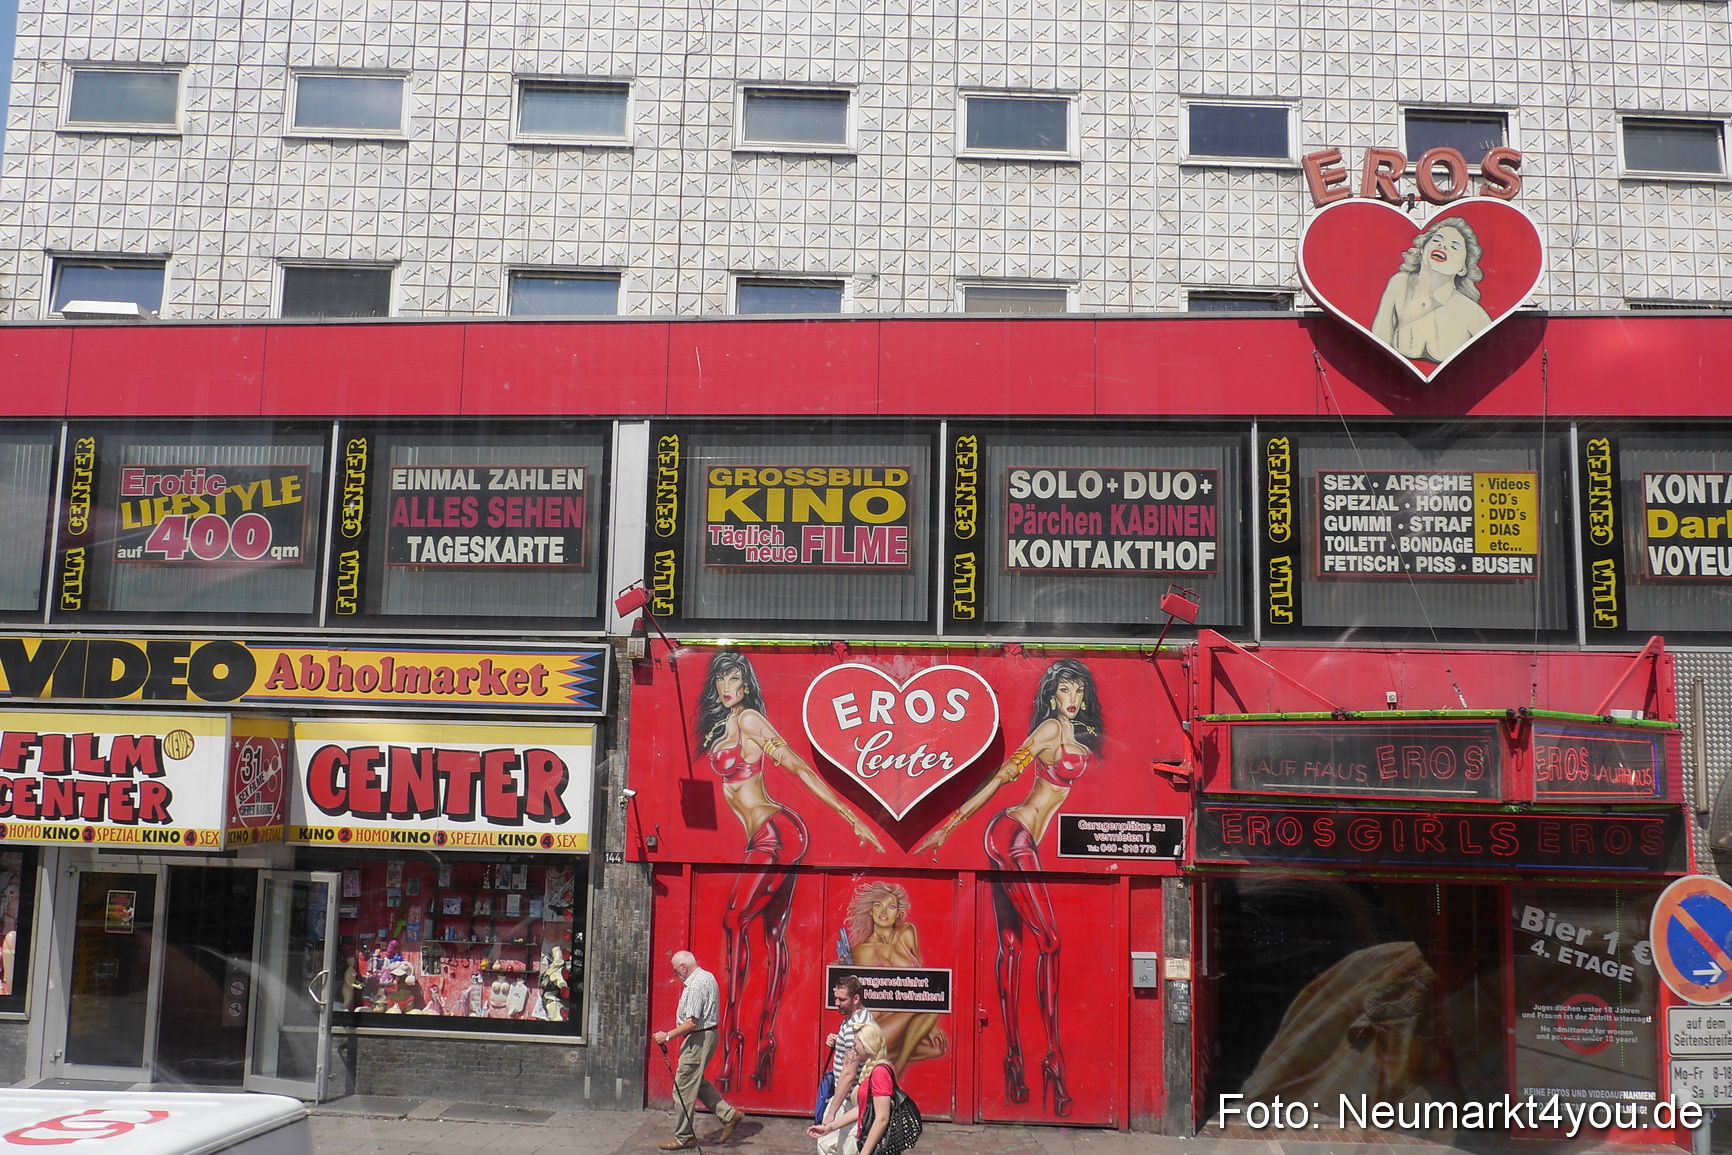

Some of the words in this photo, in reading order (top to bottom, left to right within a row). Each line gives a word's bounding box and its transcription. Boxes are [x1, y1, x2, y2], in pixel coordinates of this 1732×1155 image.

[1302, 147, 1522, 208] EROS
[68, 436, 95, 535] CENTER
[120, 468, 227, 496] Erotic
[341, 437, 368, 538] CENTER
[392, 468, 481, 491] EINMAL
[488, 468, 584, 491] ZAHLEN
[655, 434, 680, 537] CENTER
[708, 467, 909, 487] GROSSBILD
[954, 434, 978, 540] CENTER
[1267, 435, 1291, 543] CENTER
[1324, 475, 1366, 491] SEX
[1385, 475, 1473, 492] ARSCHE
[1488, 477, 1531, 490] Videos
[1587, 437, 1614, 545] CENTER
[120, 475, 302, 530] LIFESTYLE
[391, 495, 479, 528] ALLES
[487, 495, 584, 528] SEHEN
[707, 487, 907, 524] KINO
[1323, 494, 1399, 511] SPEZIAL
[1416, 495, 1473, 512] HOMO
[117, 545, 143, 559] auf
[145, 512, 273, 561] 400
[271, 545, 299, 561] qm
[1008, 503, 1102, 535] Pärchen
[1110, 504, 1216, 537] KABINEN
[1324, 515, 1391, 532] GUMMI
[1409, 516, 1472, 533] STRAF
[1489, 523, 1521, 536] DIAS
[1647, 509, 1732, 539] Dar
[407, 535, 565, 563] TAGESKARTE
[708, 524, 784, 550] Täglich
[800, 525, 908, 564] FILME
[745, 545, 798, 562] neue
[1008, 539, 1216, 570] KONTAKTHOF
[1325, 536, 1386, 552] TOILETT
[1400, 537, 1473, 554] BONDAGE
[1489, 539, 1522, 551] etc...
[1324, 555, 1399, 572] FETISCH
[1416, 556, 1455, 573] PISS
[1472, 557, 1533, 574] BUSEN
[1648, 546, 1732, 576] VOYEU
[61, 547, 84, 610] FILM
[336, 550, 359, 615] FILM
[652, 549, 675, 617] FILM
[953, 551, 976, 620] FILM
[1269, 555, 1293, 625] FILM
[1592, 558, 1618, 629] FILM
[0, 639, 256, 702] VIDEO
[265, 653, 549, 696] Abholmarket
[832, 688, 970, 730] EROS
[0, 731, 166, 778] FILM
[166, 734, 193, 759] NEWS
[241, 745, 262, 784] 31
[853, 730, 954, 779] Center
[1303, 760, 1367, 782] HAUS
[1376, 744, 1484, 781] EROS
[1535, 746, 1589, 782] EROS
[239, 787, 249, 804] SEX
[308, 744, 571, 826] CENTER
[9, 824, 41, 839] HOMO
[42, 826, 80, 840] KINO
[84, 827, 94, 841] 3
[97, 827, 140, 842] SPEZIAL
[142, 829, 180, 844] KINO
[186, 830, 195, 844] 4
[200, 831, 219, 846] SEX
[227, 830, 248, 844] KINO
[259, 827, 281, 842] SPEZIAL
[299, 827, 335, 841] KINO
[341, 829, 350, 841] 2
[356, 829, 389, 842] HOMO
[390, 830, 431, 844] KINO
[436, 832, 446, 845] 3
[450, 831, 495, 847] SPEZIAL
[498, 833, 538, 847] KINO
[541, 834, 552, 847] 4
[557, 834, 577, 848] SEX
[1078, 819, 1151, 833] Garagenplätze
[1153, 823, 1166, 832] zu
[1094, 832, 1143, 842] vermieten
[1222, 813, 1335, 848] EROS
[1348, 817, 1519, 856] GIRLS
[1537, 821, 1665, 856] EROS
[605, 853, 621, 863] 144
[1520, 905, 1593, 946] Bier
[1603, 931, 1620, 956] 1
[1632, 940, 1651, 966] €
[1530, 939, 1550, 959] 4.
[1557, 946, 1635, 983] ETAGE
[854, 975, 929, 988] arageneinfahrt
[863, 989, 893, 1000] Nacht
[895, 990, 945, 1002] freihalten!
[1686, 1017, 1703, 1029] auf
[1707, 1017, 1726, 1029] dem
[1524, 1087, 1545, 1097] KEINE
[1547, 1088, 1569, 1097] FOTOS
[1571, 1089, 1587, 1098] UND
[1692, 1085, 1705, 1098] Sa
